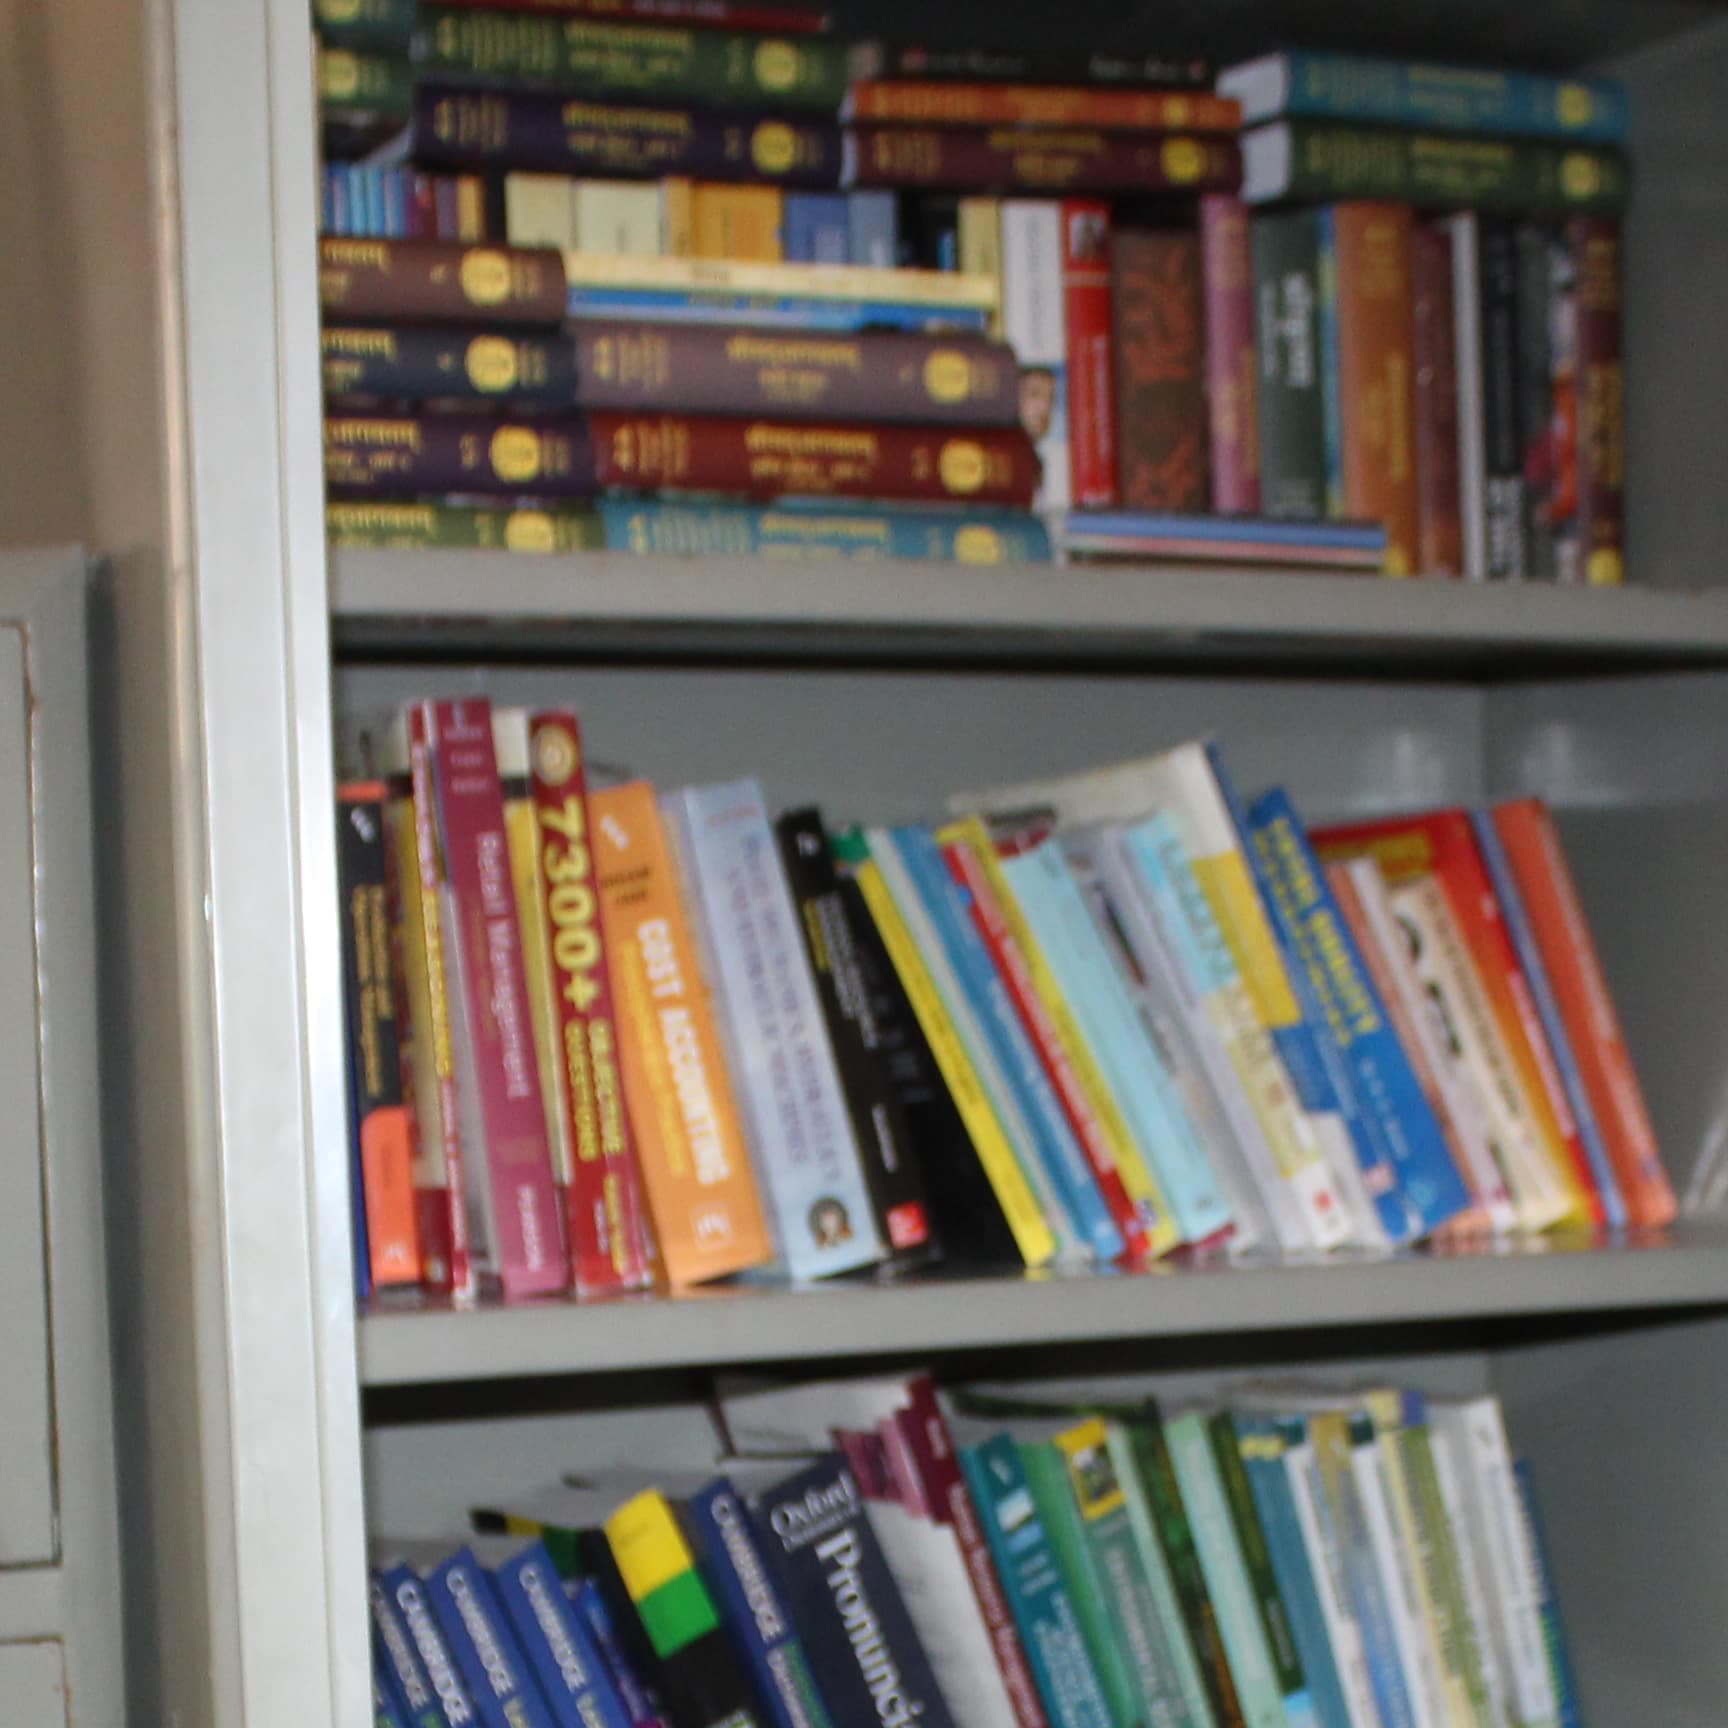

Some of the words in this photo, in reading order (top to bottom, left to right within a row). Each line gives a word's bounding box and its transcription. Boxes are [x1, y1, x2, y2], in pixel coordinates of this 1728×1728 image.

[478, 832, 508, 915] Retail
[539, 800, 600, 1010] 7300+
[487, 921, 532, 1098] Management
[636, 918, 680, 998] COST
[659, 1004, 730, 1186] ACCOUNTING
[564, 1020, 599, 1161] QUESTIONS
[589, 1018, 624, 1154] OBJECTIVE
[770, 1472, 856, 1539] Oxford
[394, 1579, 474, 1728] CAMBRIDGE
[444, 1566, 516, 1698] CAMBRIDGE
[518, 1561, 590, 1692] CAMBRIDGE
